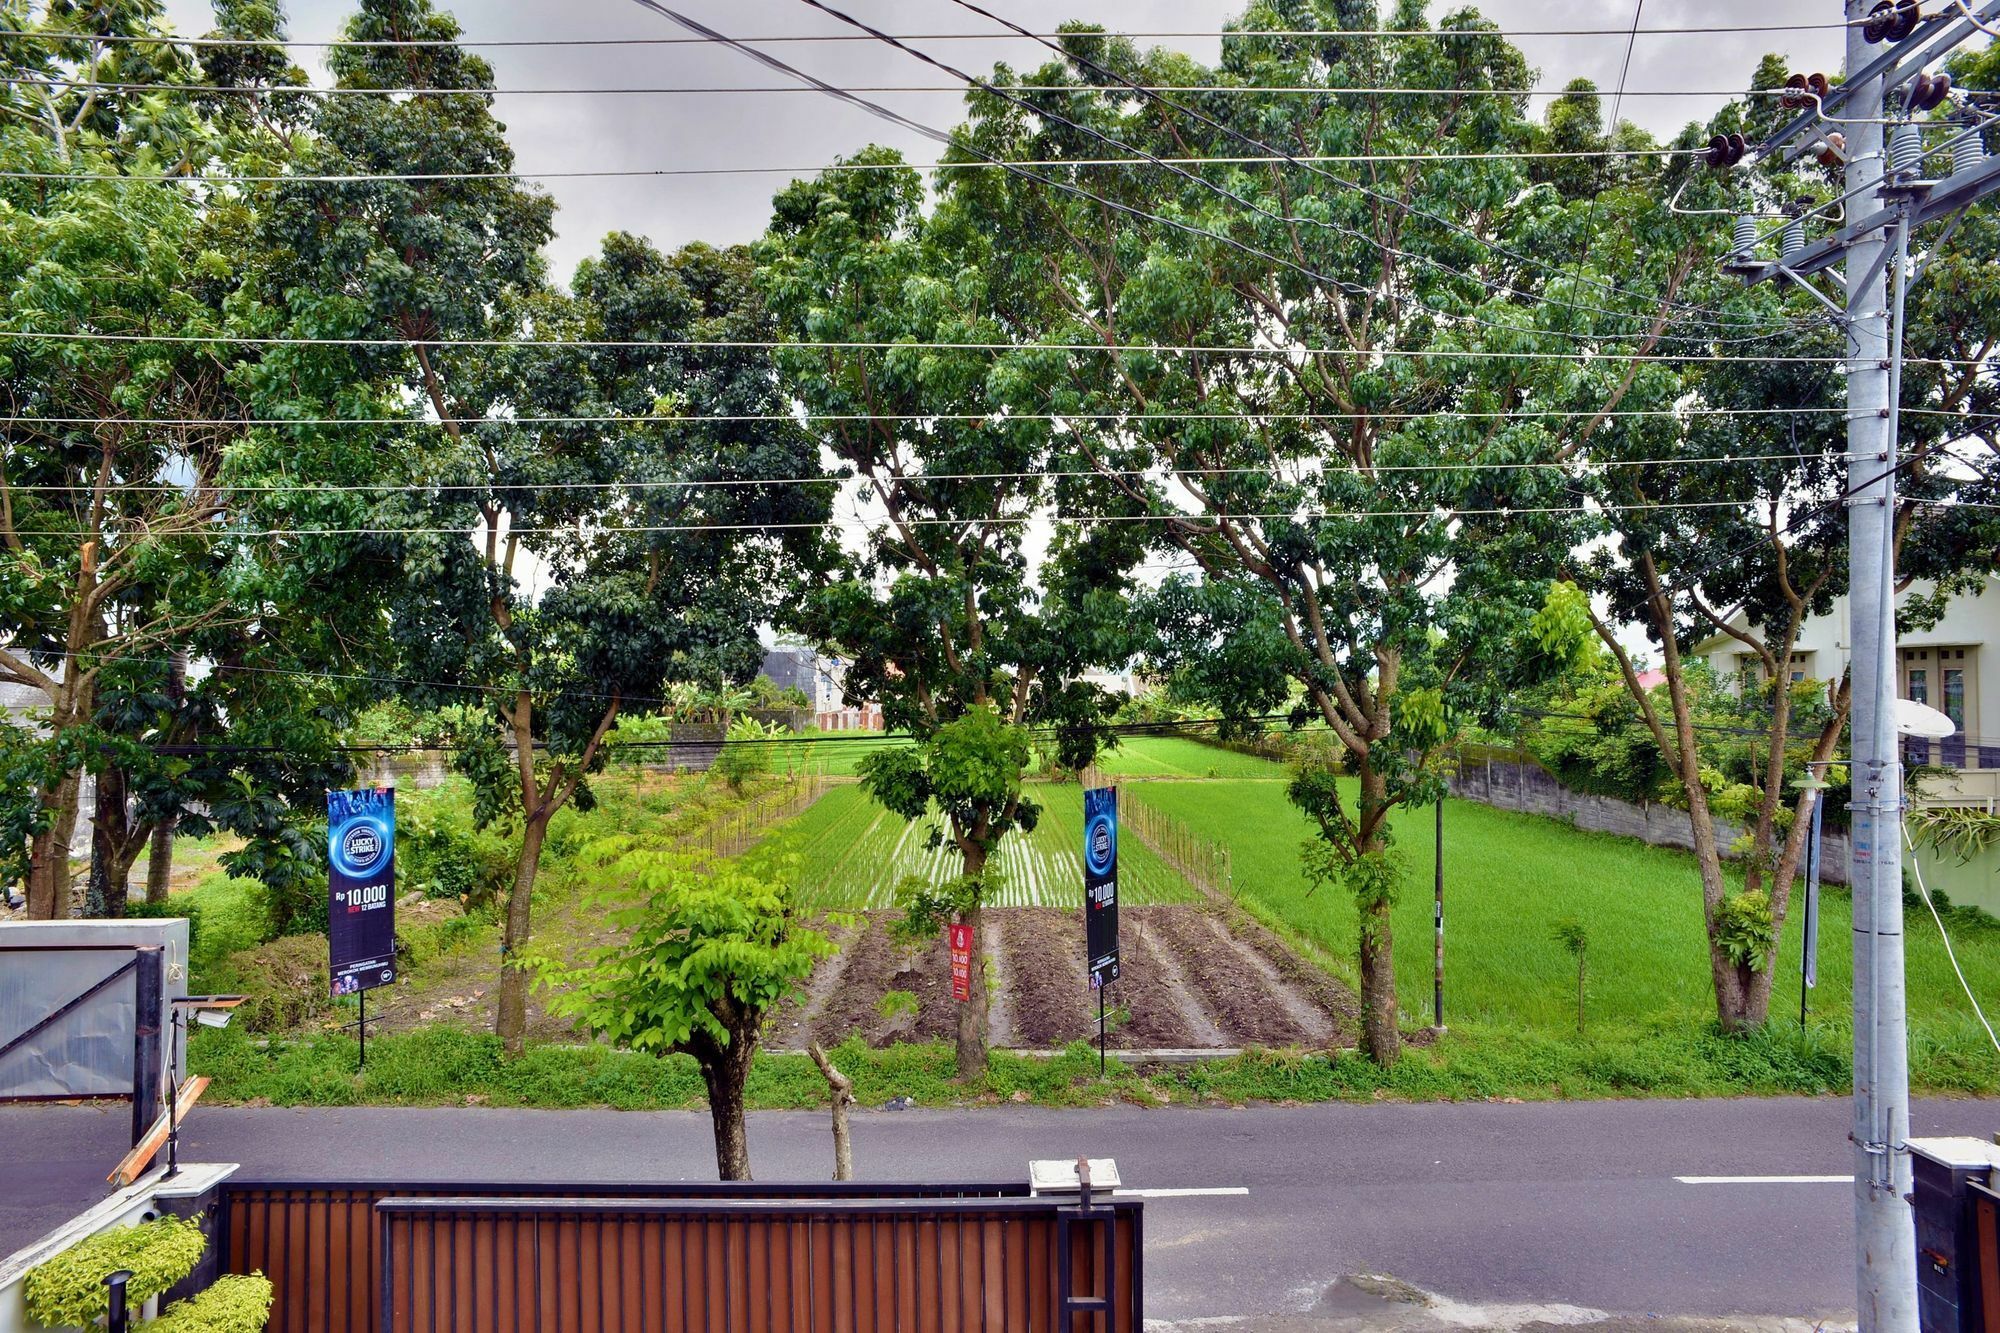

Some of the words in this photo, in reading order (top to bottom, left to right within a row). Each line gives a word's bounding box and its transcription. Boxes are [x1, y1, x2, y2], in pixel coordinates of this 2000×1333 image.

[351, 837, 374, 847] LUCKY
[350, 844, 375, 855] STRIKE
[335, 892, 345, 902] Rp
[1094, 882, 1114, 903] 10.000
[361, 903, 368, 911] 12
[368, 901, 386, 909] BATANG
